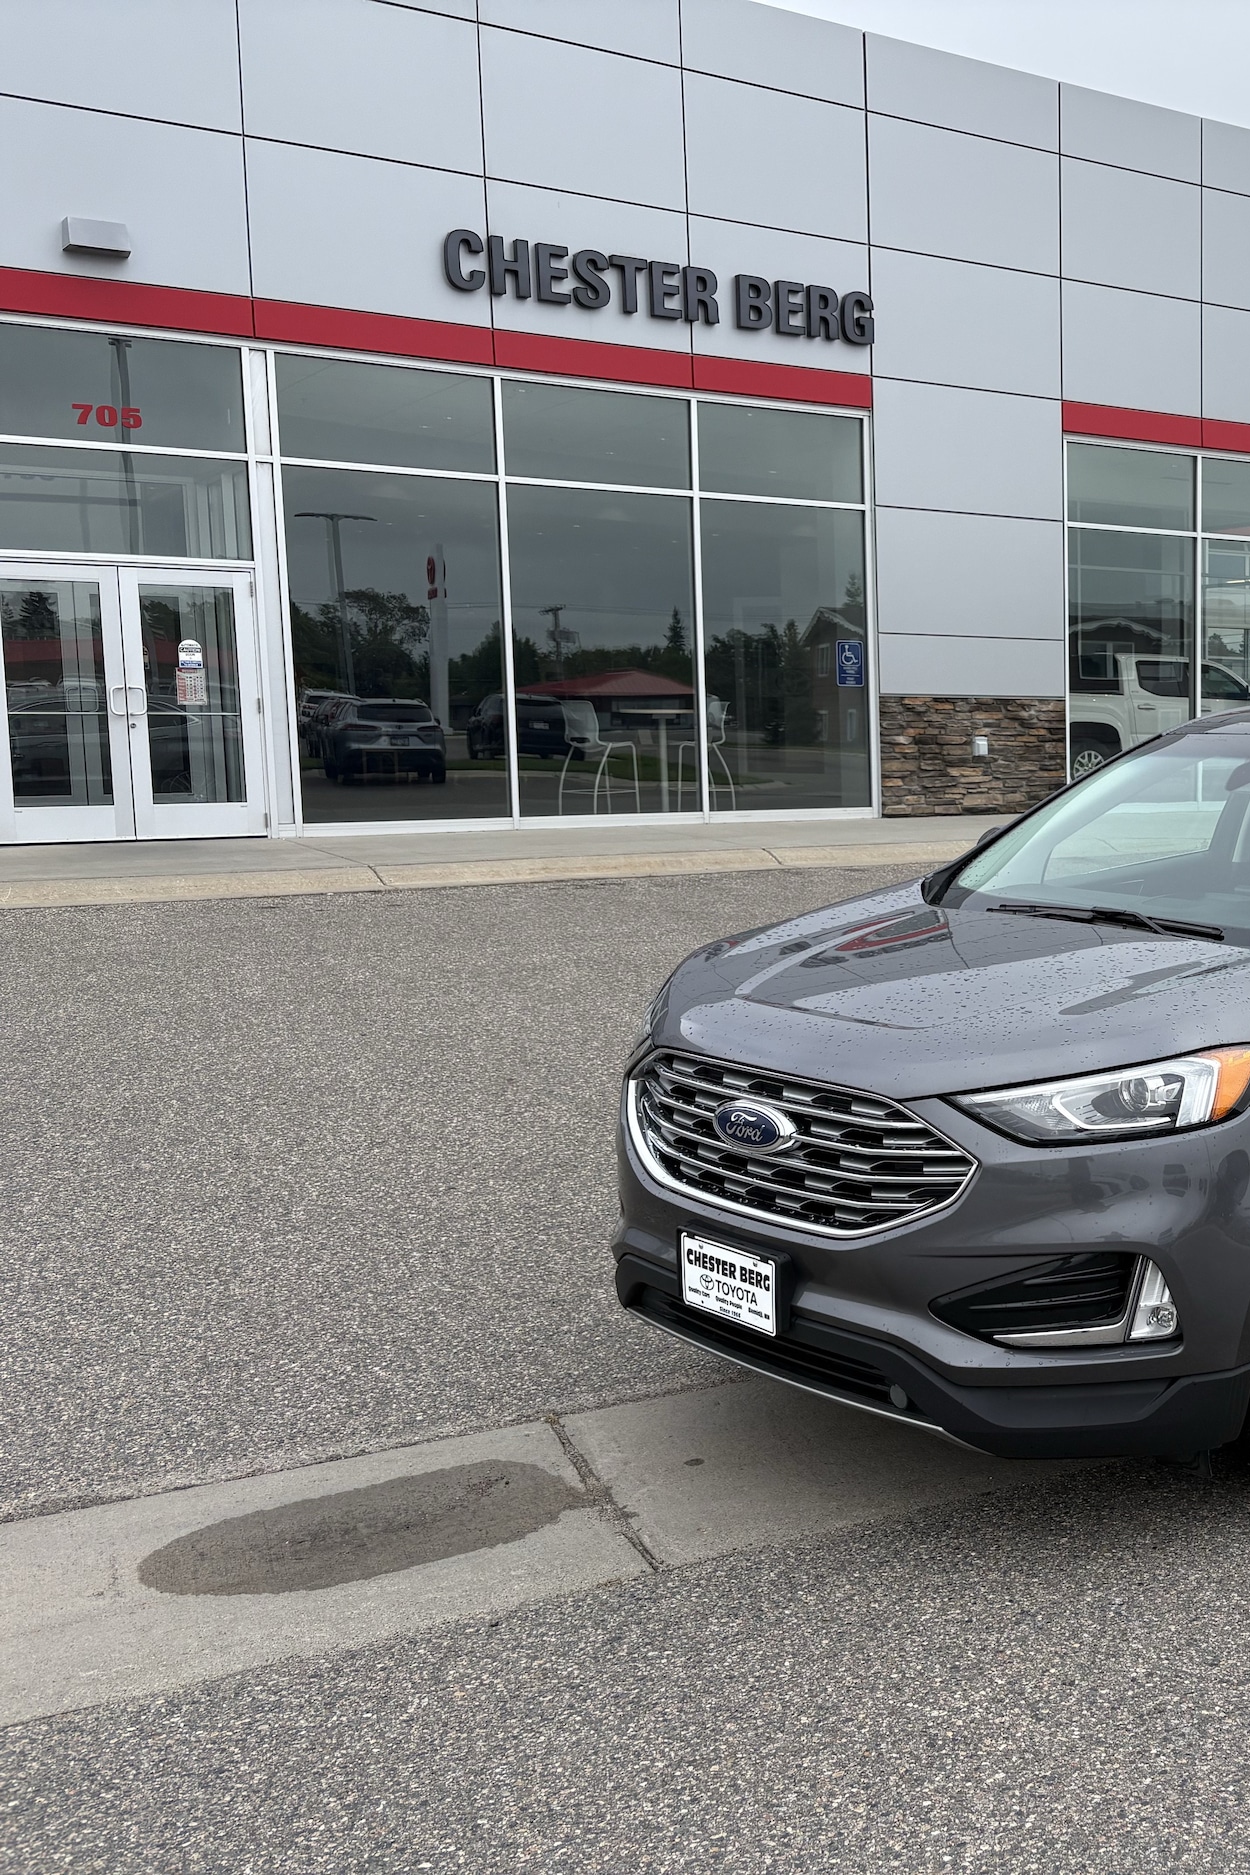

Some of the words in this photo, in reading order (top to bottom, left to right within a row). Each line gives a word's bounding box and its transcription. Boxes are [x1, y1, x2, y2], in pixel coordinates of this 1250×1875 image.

[443, 228, 720, 325] CHESTER
[734, 273, 875, 345] BERG
[71, 402, 143, 429] 705
[725, 1111, 766, 1141] Ford
[686, 1248, 737, 1280] CHESTER
[739, 1265, 770, 1292] BERG
[715, 1279, 758, 1306] TOYOTA
